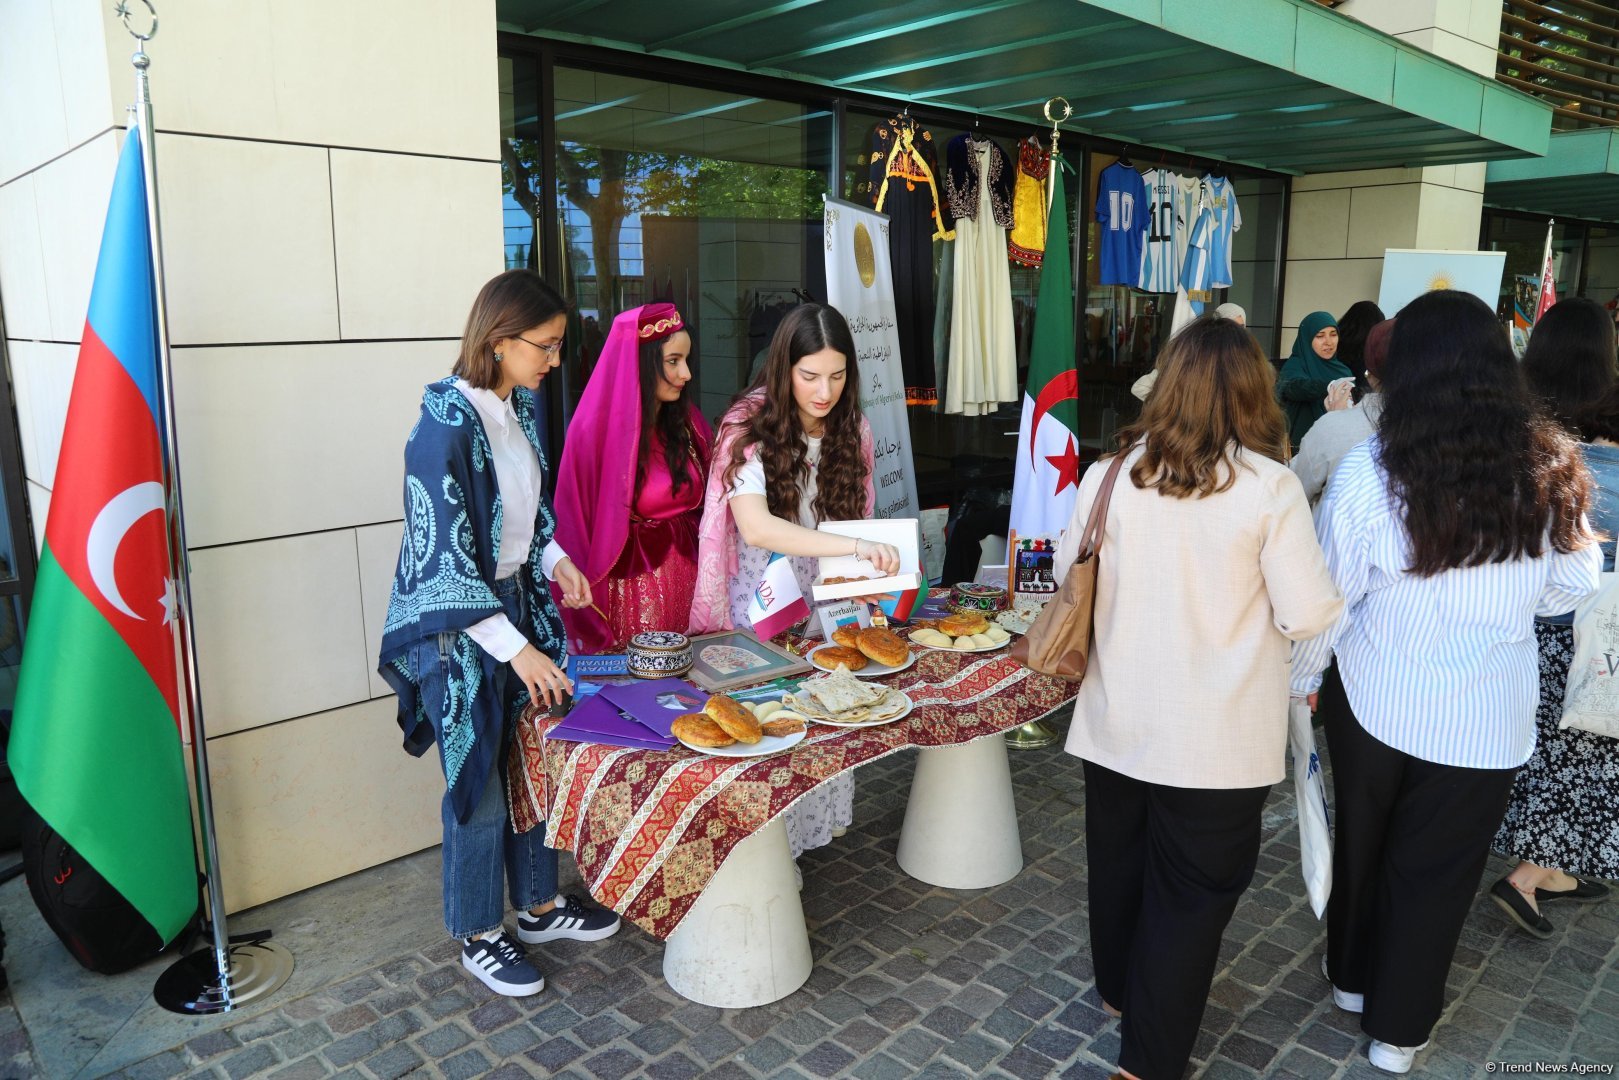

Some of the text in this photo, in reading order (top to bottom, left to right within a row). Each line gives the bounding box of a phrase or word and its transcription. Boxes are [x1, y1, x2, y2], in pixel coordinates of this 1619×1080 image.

[1109, 190, 1134, 232] 10
[1149, 202, 1173, 242] 10
[884, 436, 902, 458] مرحبا
[880, 468, 904, 489] WELCOME
[759, 580, 776, 607] ADA
[828, 605, 861, 618] Azerbaijan
